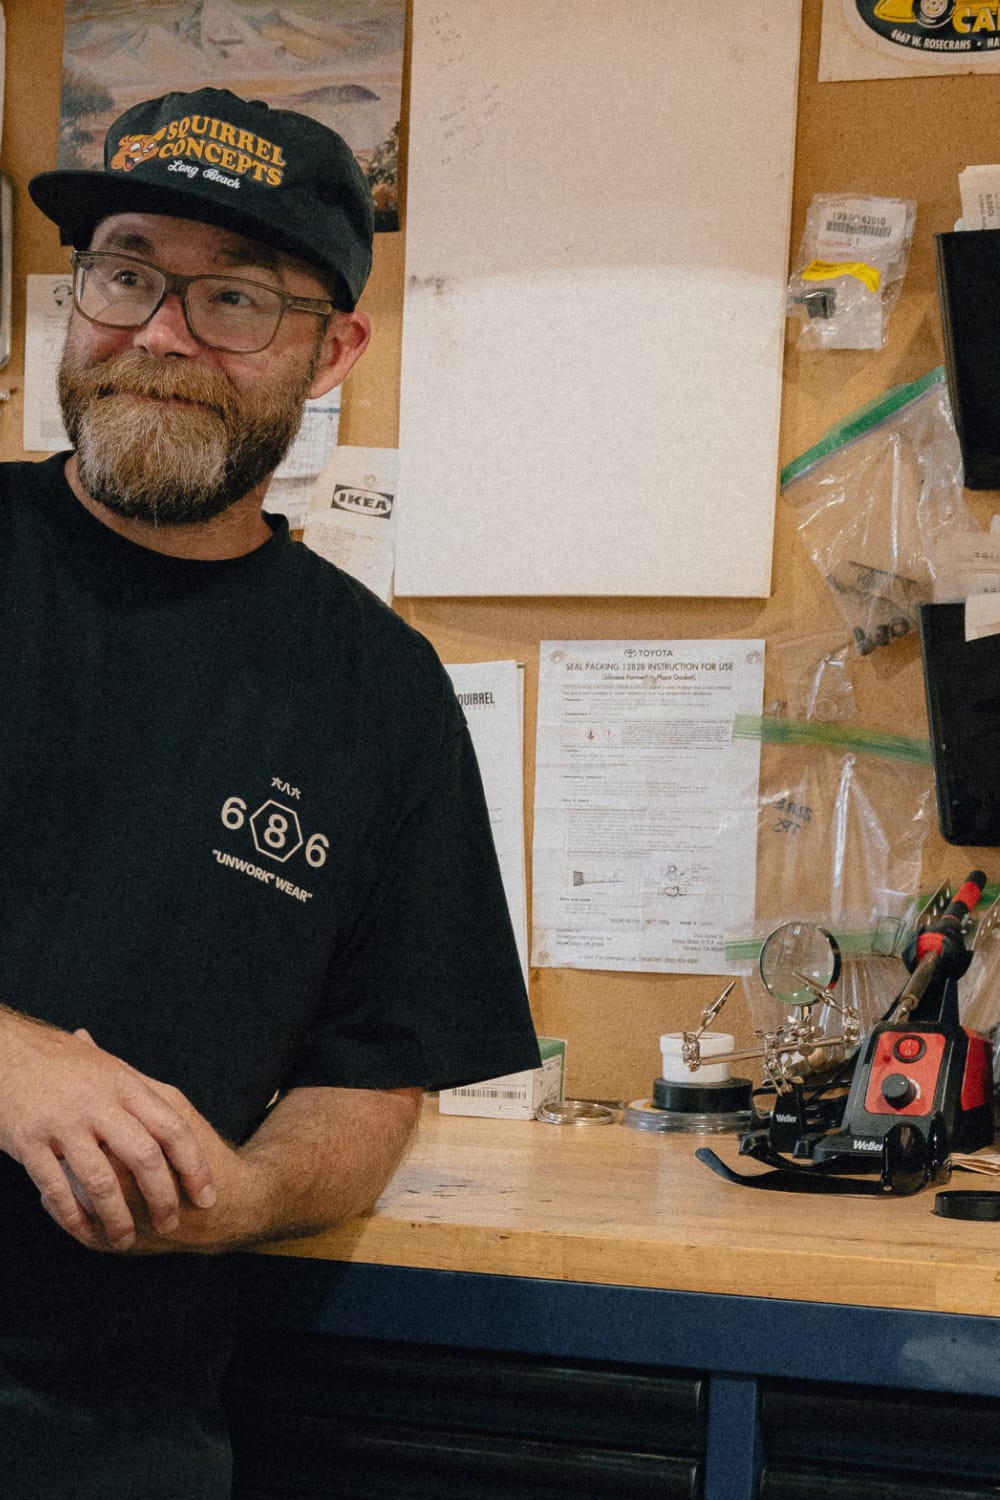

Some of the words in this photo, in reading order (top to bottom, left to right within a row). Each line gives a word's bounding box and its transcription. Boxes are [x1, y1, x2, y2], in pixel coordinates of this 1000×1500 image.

[952, 7, 1000, 33] CA
[924, 38, 972, 50] ROSECRANS
[166, 114, 287, 167] SQUIRREL
[158, 137, 284, 186] CONCEPTS
[167, 159, 199, 178] Long
[202, 168, 241, 189] Beach
[338, 492, 389, 511] IKEA
[638, 649, 674, 657] TOYOTA
[565, 663, 584, 671] SEAL
[585, 663, 620, 671] PACKING
[647, 663, 699, 671] INSTRUCTION
[701, 663, 717, 671] FOR
[719, 663, 734, 671] USE
[775, 1113, 798, 1123] Weller
[853, 1139, 884, 1151] Weller
